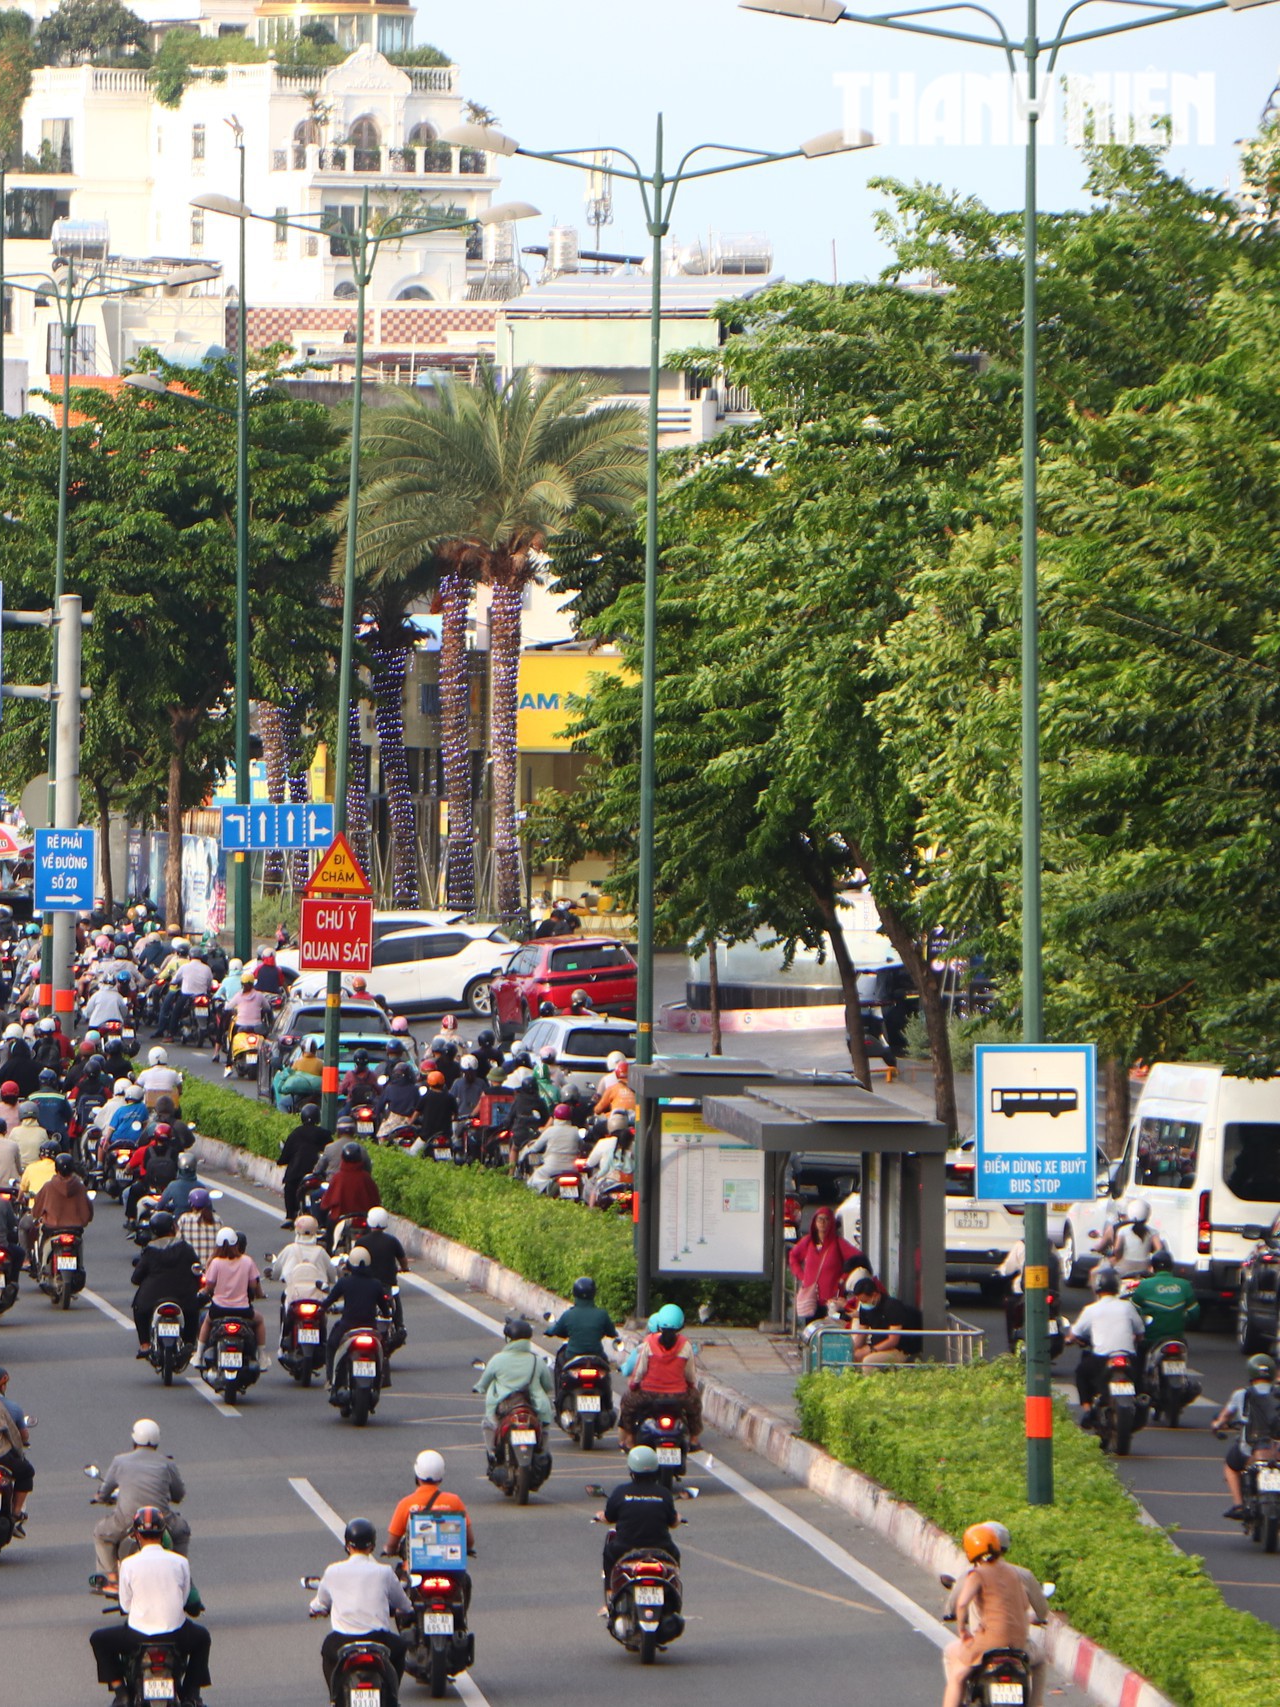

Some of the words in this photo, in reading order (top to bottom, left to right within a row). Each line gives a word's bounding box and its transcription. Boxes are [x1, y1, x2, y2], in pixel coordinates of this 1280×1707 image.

[47, 834, 60, 848] RẼ
[61, 832, 82, 849] PHẢI
[42, 852, 54, 868] VỀ
[55, 853, 88, 869] ĐƯỜNG
[334, 855, 345, 865] ĐI
[52, 872, 65, 889] SỐ
[66, 877, 78, 889] 20
[321, 870, 355, 884] CHẬM
[316, 905, 344, 929] CHÚ
[348, 905, 357, 930] Ý
[302, 940, 340, 962] QUAN
[343, 938, 368, 962] SÁT
[984, 1155, 1010, 1174] ĐIỂM
[1012, 1157, 1042, 1174] DỪNG
[1044, 1160, 1058, 1174] XE
[1061, 1157, 1087, 1174] BUÝT
[1010, 1179, 1032, 1193] BUS
[1034, 1179, 1061, 1193] STOP
[1156, 1284, 1182, 1294] Grab
